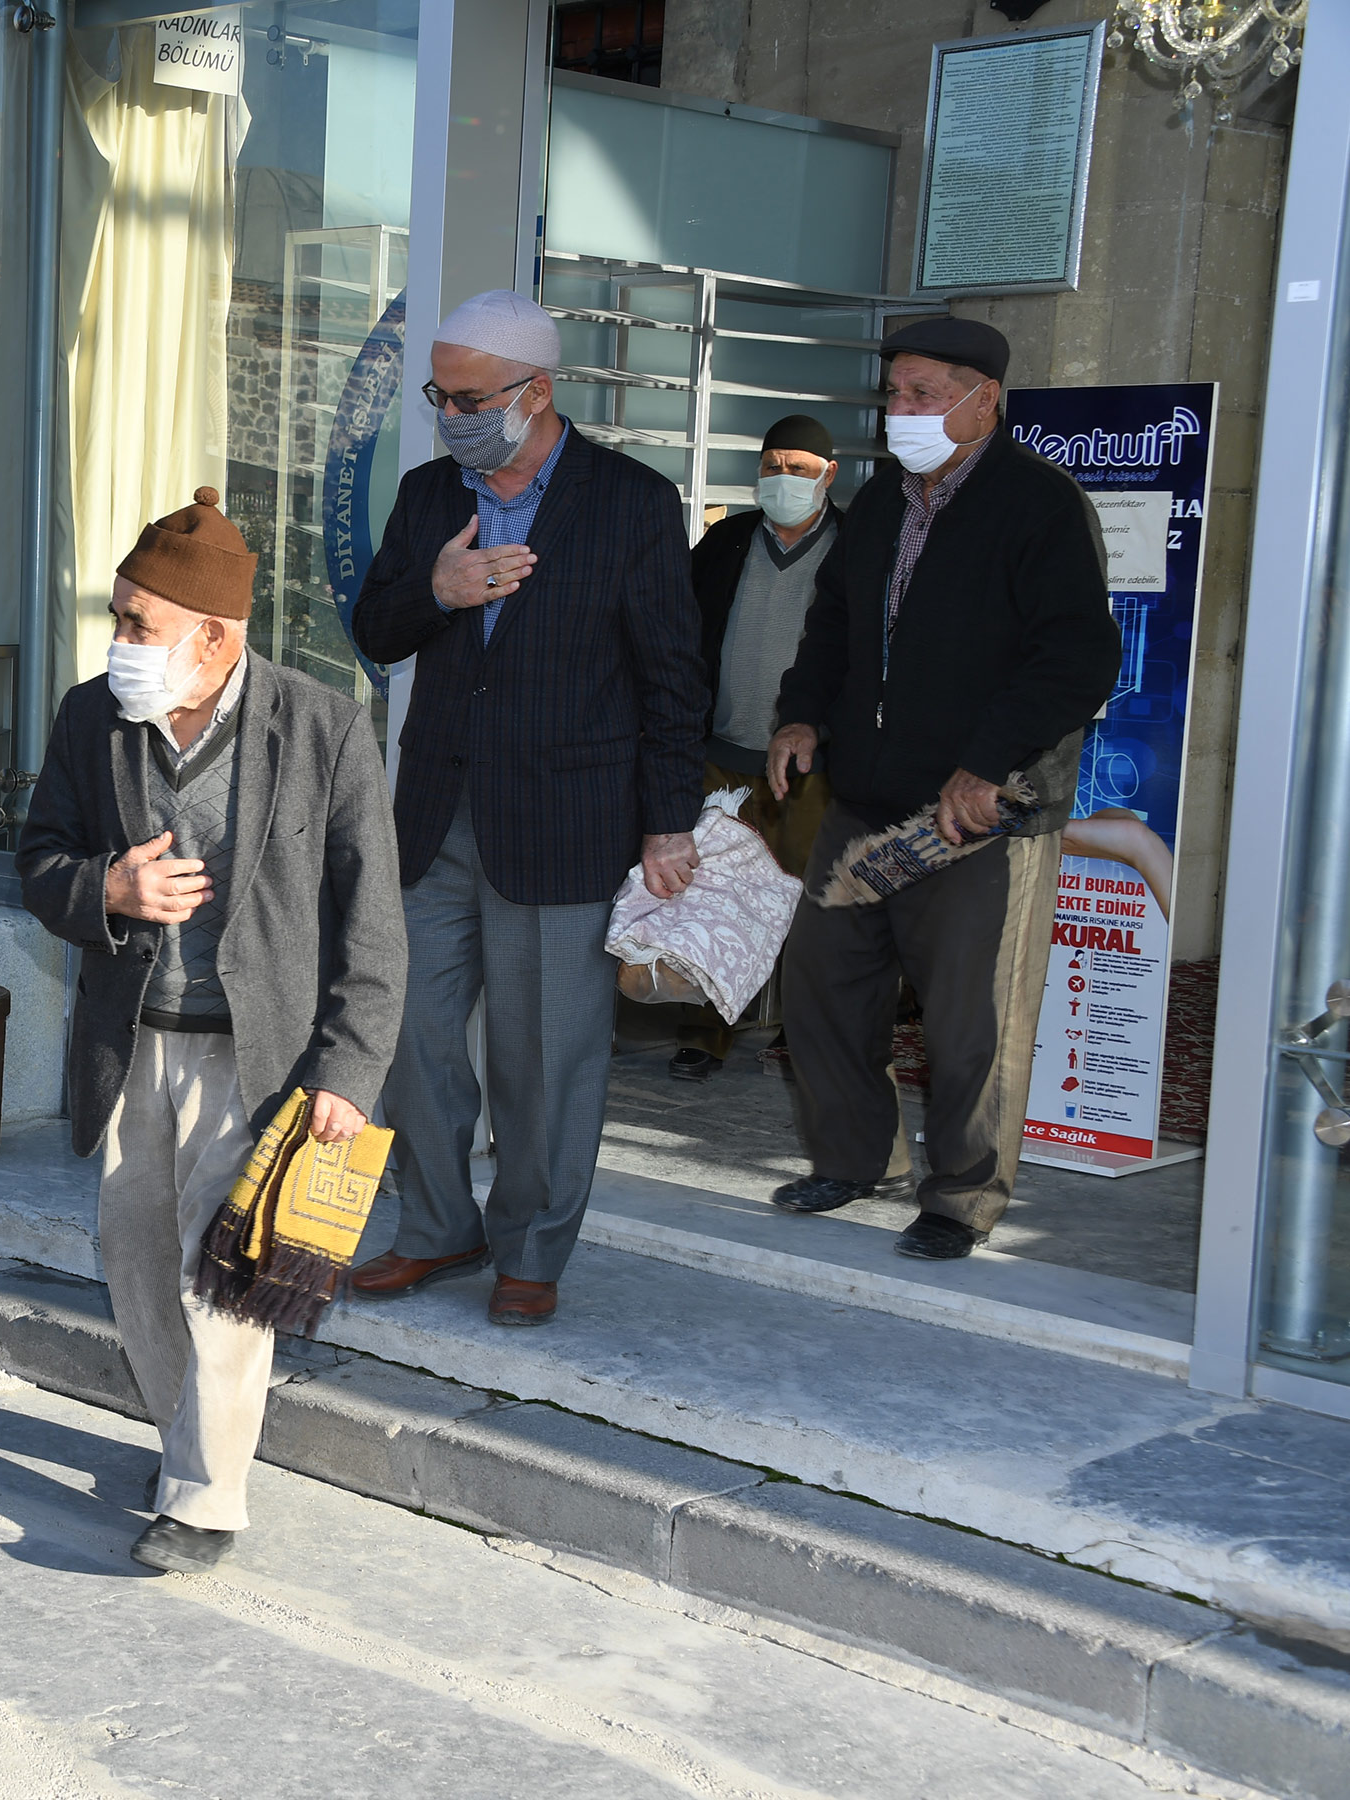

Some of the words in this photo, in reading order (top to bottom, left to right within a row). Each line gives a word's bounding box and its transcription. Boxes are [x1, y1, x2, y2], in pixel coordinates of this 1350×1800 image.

[157, 40, 234, 72] BÖLÜMÜ
[1013, 421, 1183, 467] Kentwifi
[334, 446, 358, 580] DİYANET
[1095, 499, 1146, 509] dezenfektan
[1127, 575, 1160, 585] edebilir.
[1085, 877, 1146, 897] BURADA
[1096, 898, 1146, 918] EDİNİZ
[1051, 922, 1141, 955] KURAL
[1049, 1126, 1097, 1145] Sağlık
